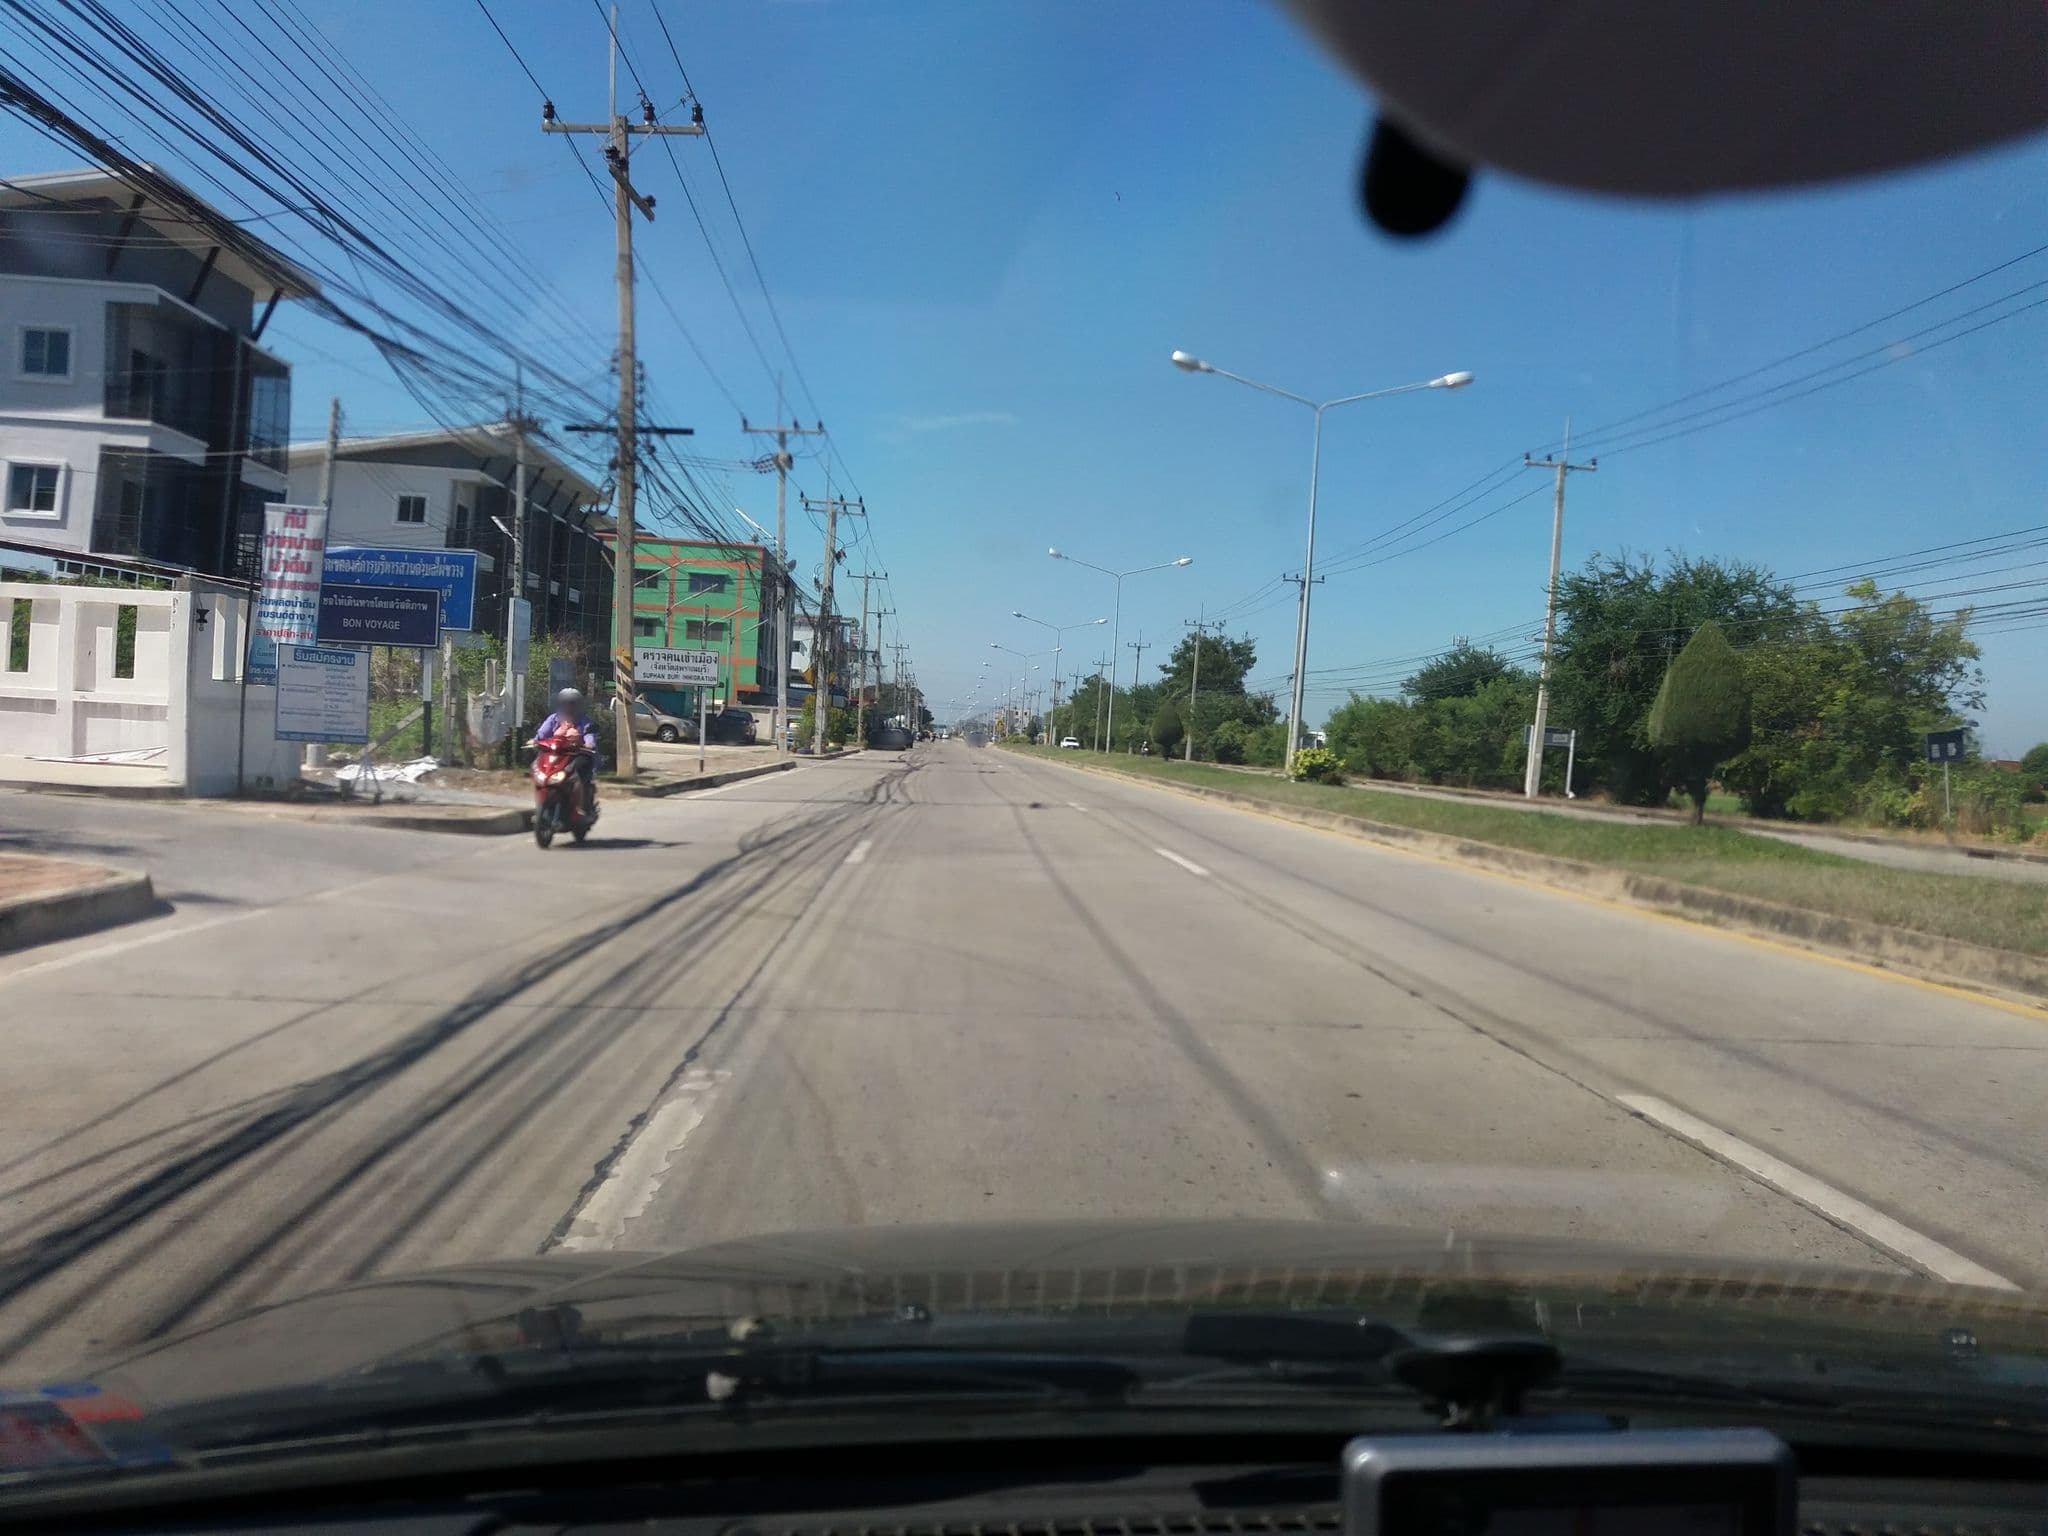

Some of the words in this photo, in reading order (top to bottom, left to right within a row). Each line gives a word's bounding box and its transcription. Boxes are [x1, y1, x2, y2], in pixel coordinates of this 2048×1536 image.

[343, 618, 362, 628] BON
[365, 618, 401, 630] VOYAGE
[295, 648, 354, 665] รับสมัครงาน
[642, 651, 718, 664] ตรวจคนเข้าเมือง
[681, 674, 717, 682] IMMIGRATION
